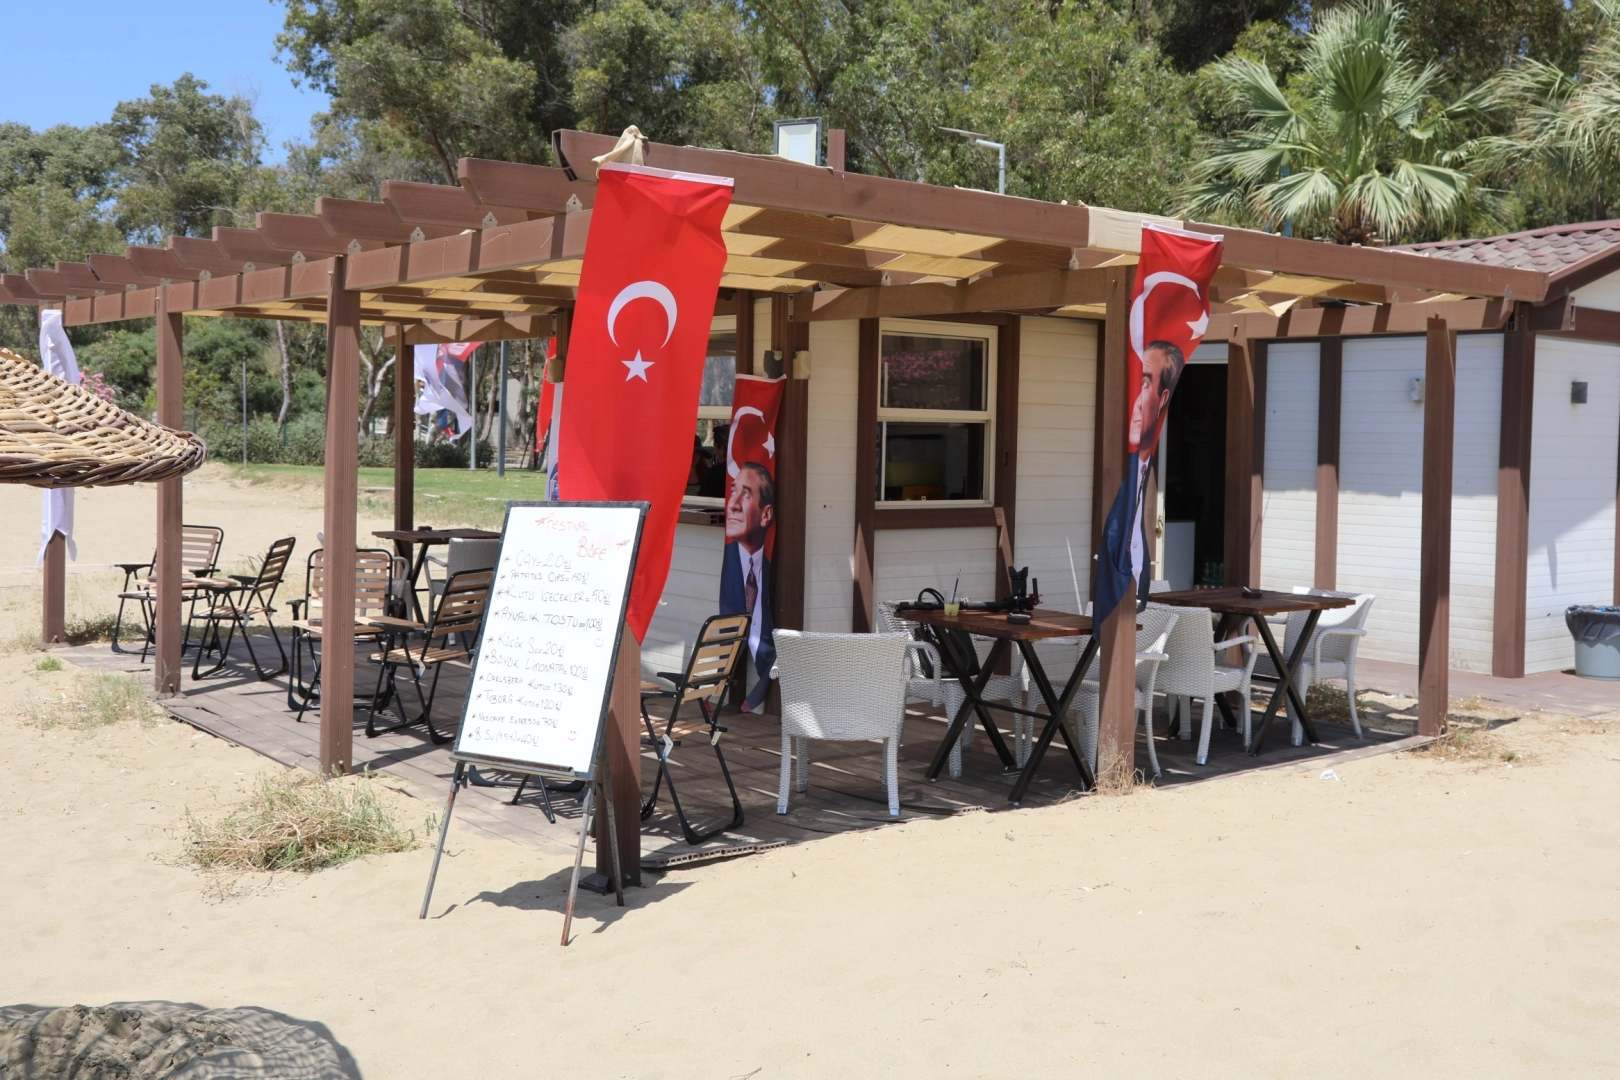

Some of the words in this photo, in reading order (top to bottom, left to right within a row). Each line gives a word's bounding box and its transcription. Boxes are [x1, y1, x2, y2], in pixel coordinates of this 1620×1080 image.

[510, 569, 543, 580] PATATES
[501, 605, 540, 624] AYVALIK
[478, 712, 505, 723] NESCAFE
